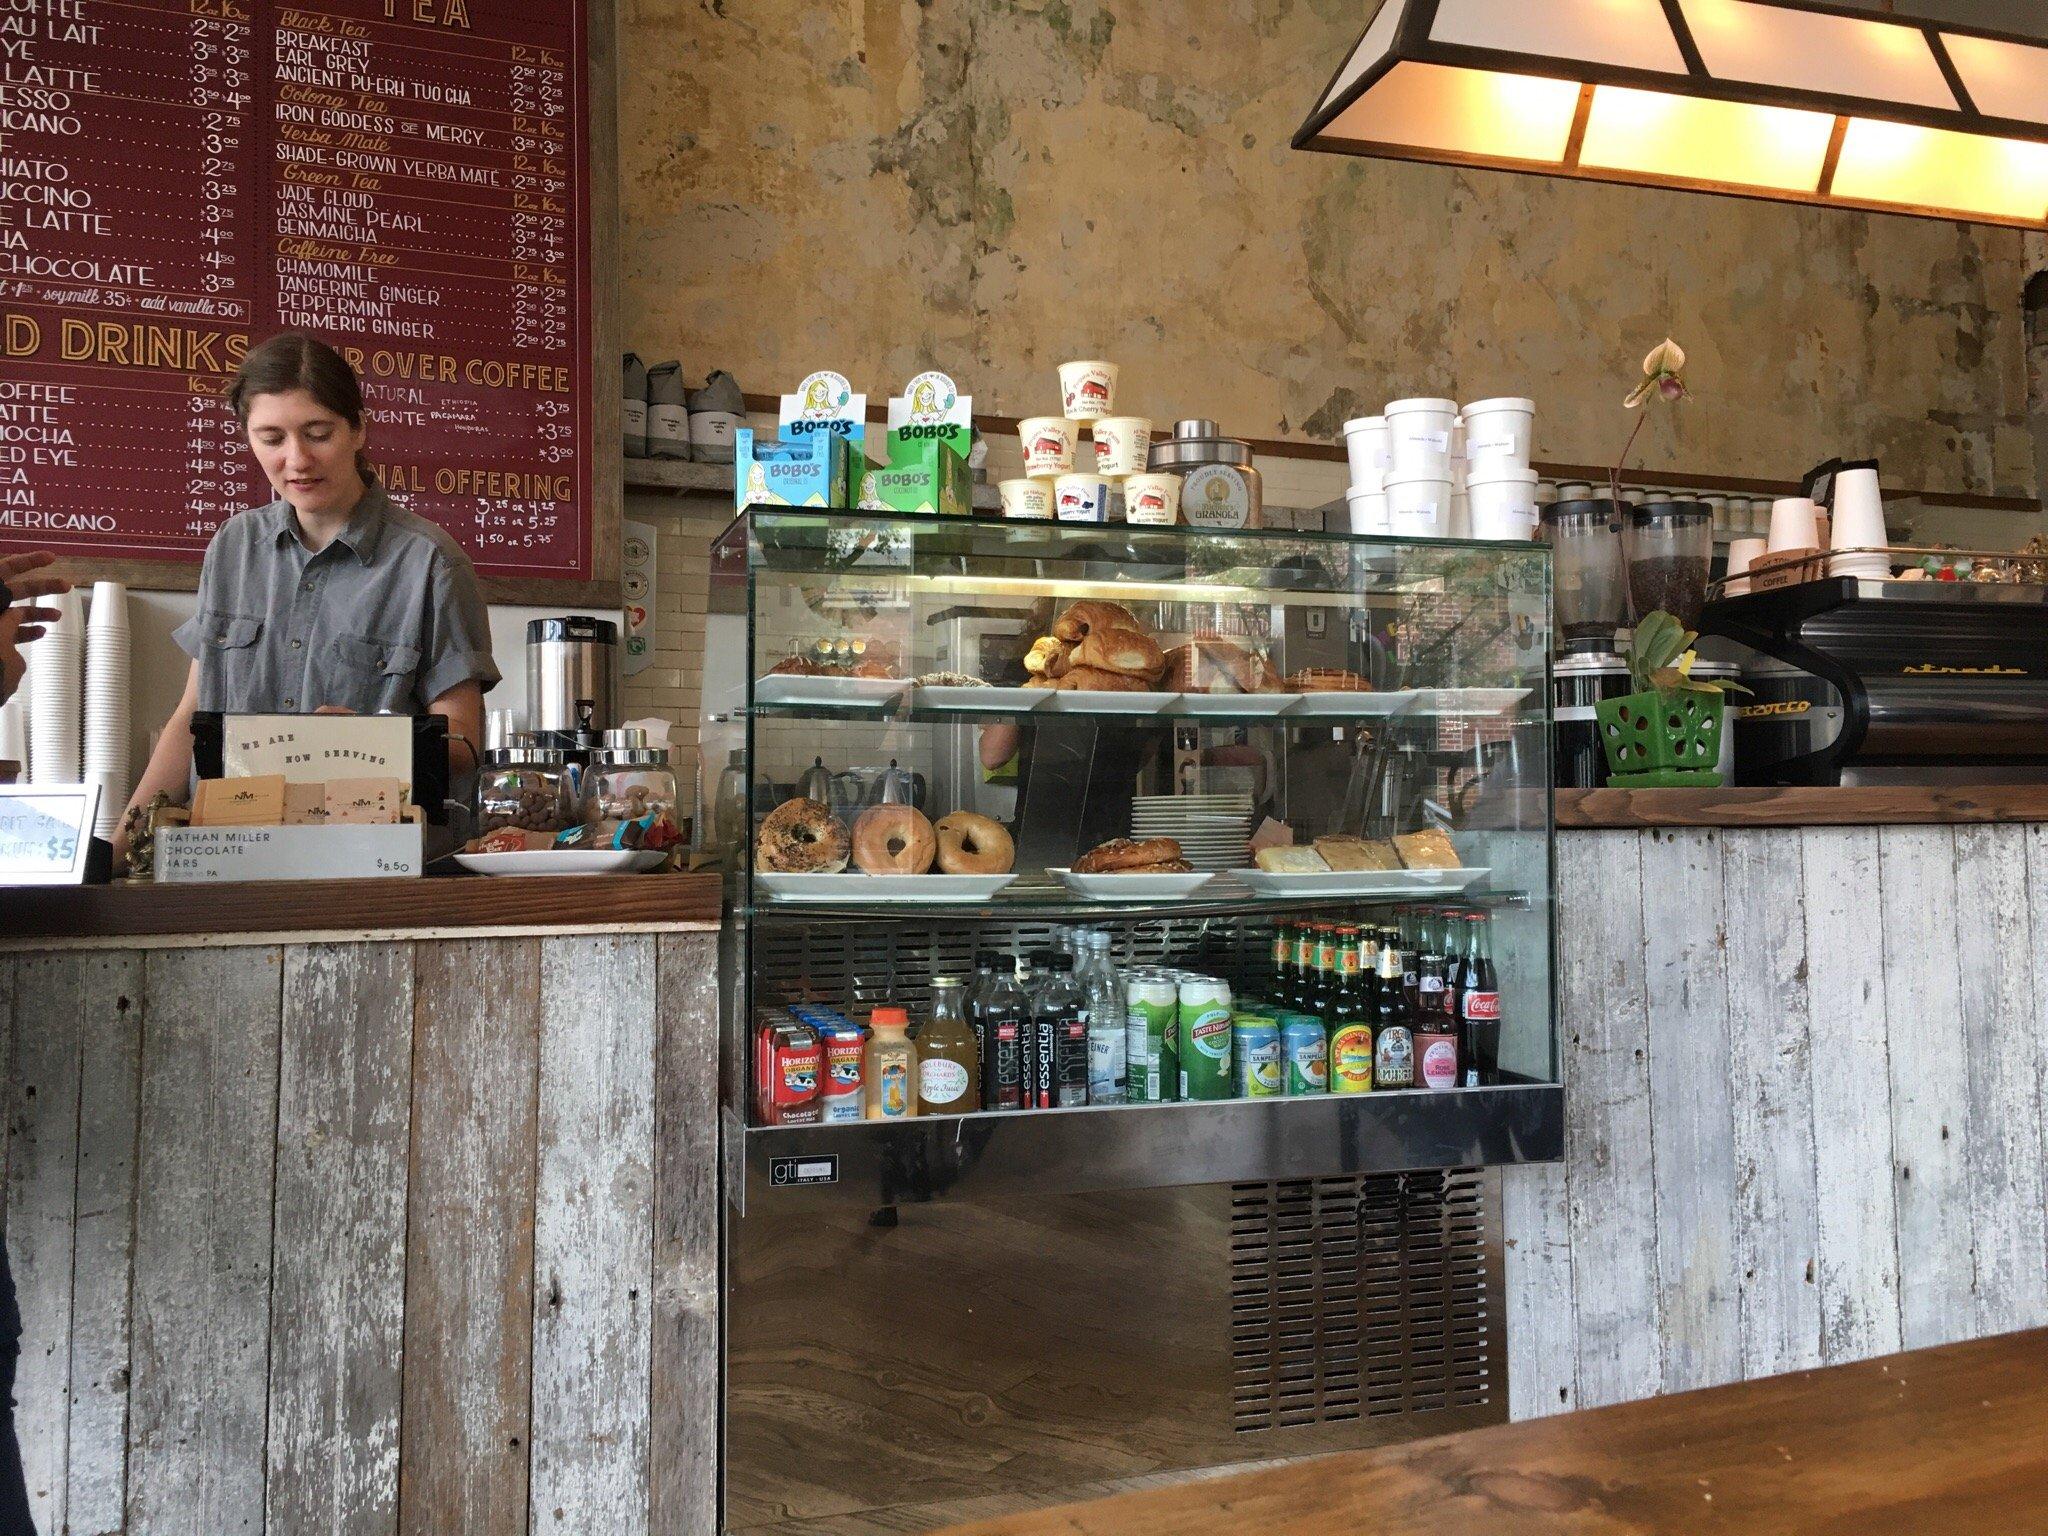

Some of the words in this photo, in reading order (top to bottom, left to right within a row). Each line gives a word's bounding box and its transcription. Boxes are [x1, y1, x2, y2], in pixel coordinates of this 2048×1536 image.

[0, 16, 36, 36] AU
[49, 21, 105, 45] LAIT
[281, 10, 333, 32] Black
[337, 18, 371, 38] Tea
[276, 29, 373, 57] BREAKFAST
[276, 47, 316, 67] EARL
[326, 54, 370, 73] GREY
[6, 63, 100, 92] LATTE
[275, 64, 345, 87] ANCIENT
[351, 74, 404, 96] PU-ERH
[411, 82, 441, 101] TUO
[445, 88, 471, 105] CHA
[280, 84, 347, 110] Oolong
[355, 94, 388, 112] Tea
[276, 104, 313, 123] IRON
[321, 110, 394, 134] GODDESS
[427, 124, 484, 145] MERCY
[281, 124, 332, 144] Yerba
[276, 143, 396, 174] SHADE-GROWN
[403, 159, 457, 181] YERBA
[283, 164, 342, 185] Green
[349, 172, 381, 190] Tea
[277, 184, 315, 202] JADE
[323, 190, 374, 209] CLOUD
[27, 208, 112, 236] LATTE
[277, 201, 357, 225] JASMINE
[367, 211, 430, 234] PEARL
[278, 218, 377, 244] GENMAICHA
[278, 238, 351, 260] Caffeine
[358, 247, 399, 265] Free
[0, 253, 155, 286] CHOCOLATE
[277, 258, 378, 283] CHAMOMILE
[276, 274, 368, 299] TANGERINE
[380, 285, 440, 306] GINGER
[141, 296, 165, 311] add
[169, 297, 215, 316] vanilla
[278, 292, 395, 317] PEPPERMINT
[277, 310, 365, 332] TURMERIC
[372, 320, 434, 339] GINGER
[61, 318, 249, 373] DRINKS
[372, 350, 457, 383] OVER
[466, 359, 570, 393] COFFEE
[0, 425, 74, 445] OCHA
[899, 423, 962, 442] BOBO'S
[34, 448, 77, 466] EYE
[771, 463, 821, 477] BOBO'S
[881, 473, 931, 487] BOBO'S
[435, 468, 570, 502] OFFERING
[529, 501, 555, 515] 4.25
[475, 515, 506, 528] 4.25
[528, 516, 558, 529] 5.25
[475, 534, 504, 548] 4.50
[524, 535, 553, 548] 5.75
[1763, 575, 1788, 587] COFFEE
[242, 740, 259, 751] WE
[269, 734, 295, 745] ARE
[285, 753, 311, 764] NOW
[325, 750, 385, 765] SERVING
[48, 836, 74, 861] $5
[165, 833, 220, 843] NATHAN
[226, 832, 271, 842] MILLER
[164, 845, 244, 856] CHOCOLATE
[206, 869, 218, 877] PA
[377, 858, 409, 873] $8.50
[1023, 1023, 1031, 1090] essentia
[1038, 1023, 1050, 1090] essentia
[774, 1159, 797, 1184] gti
